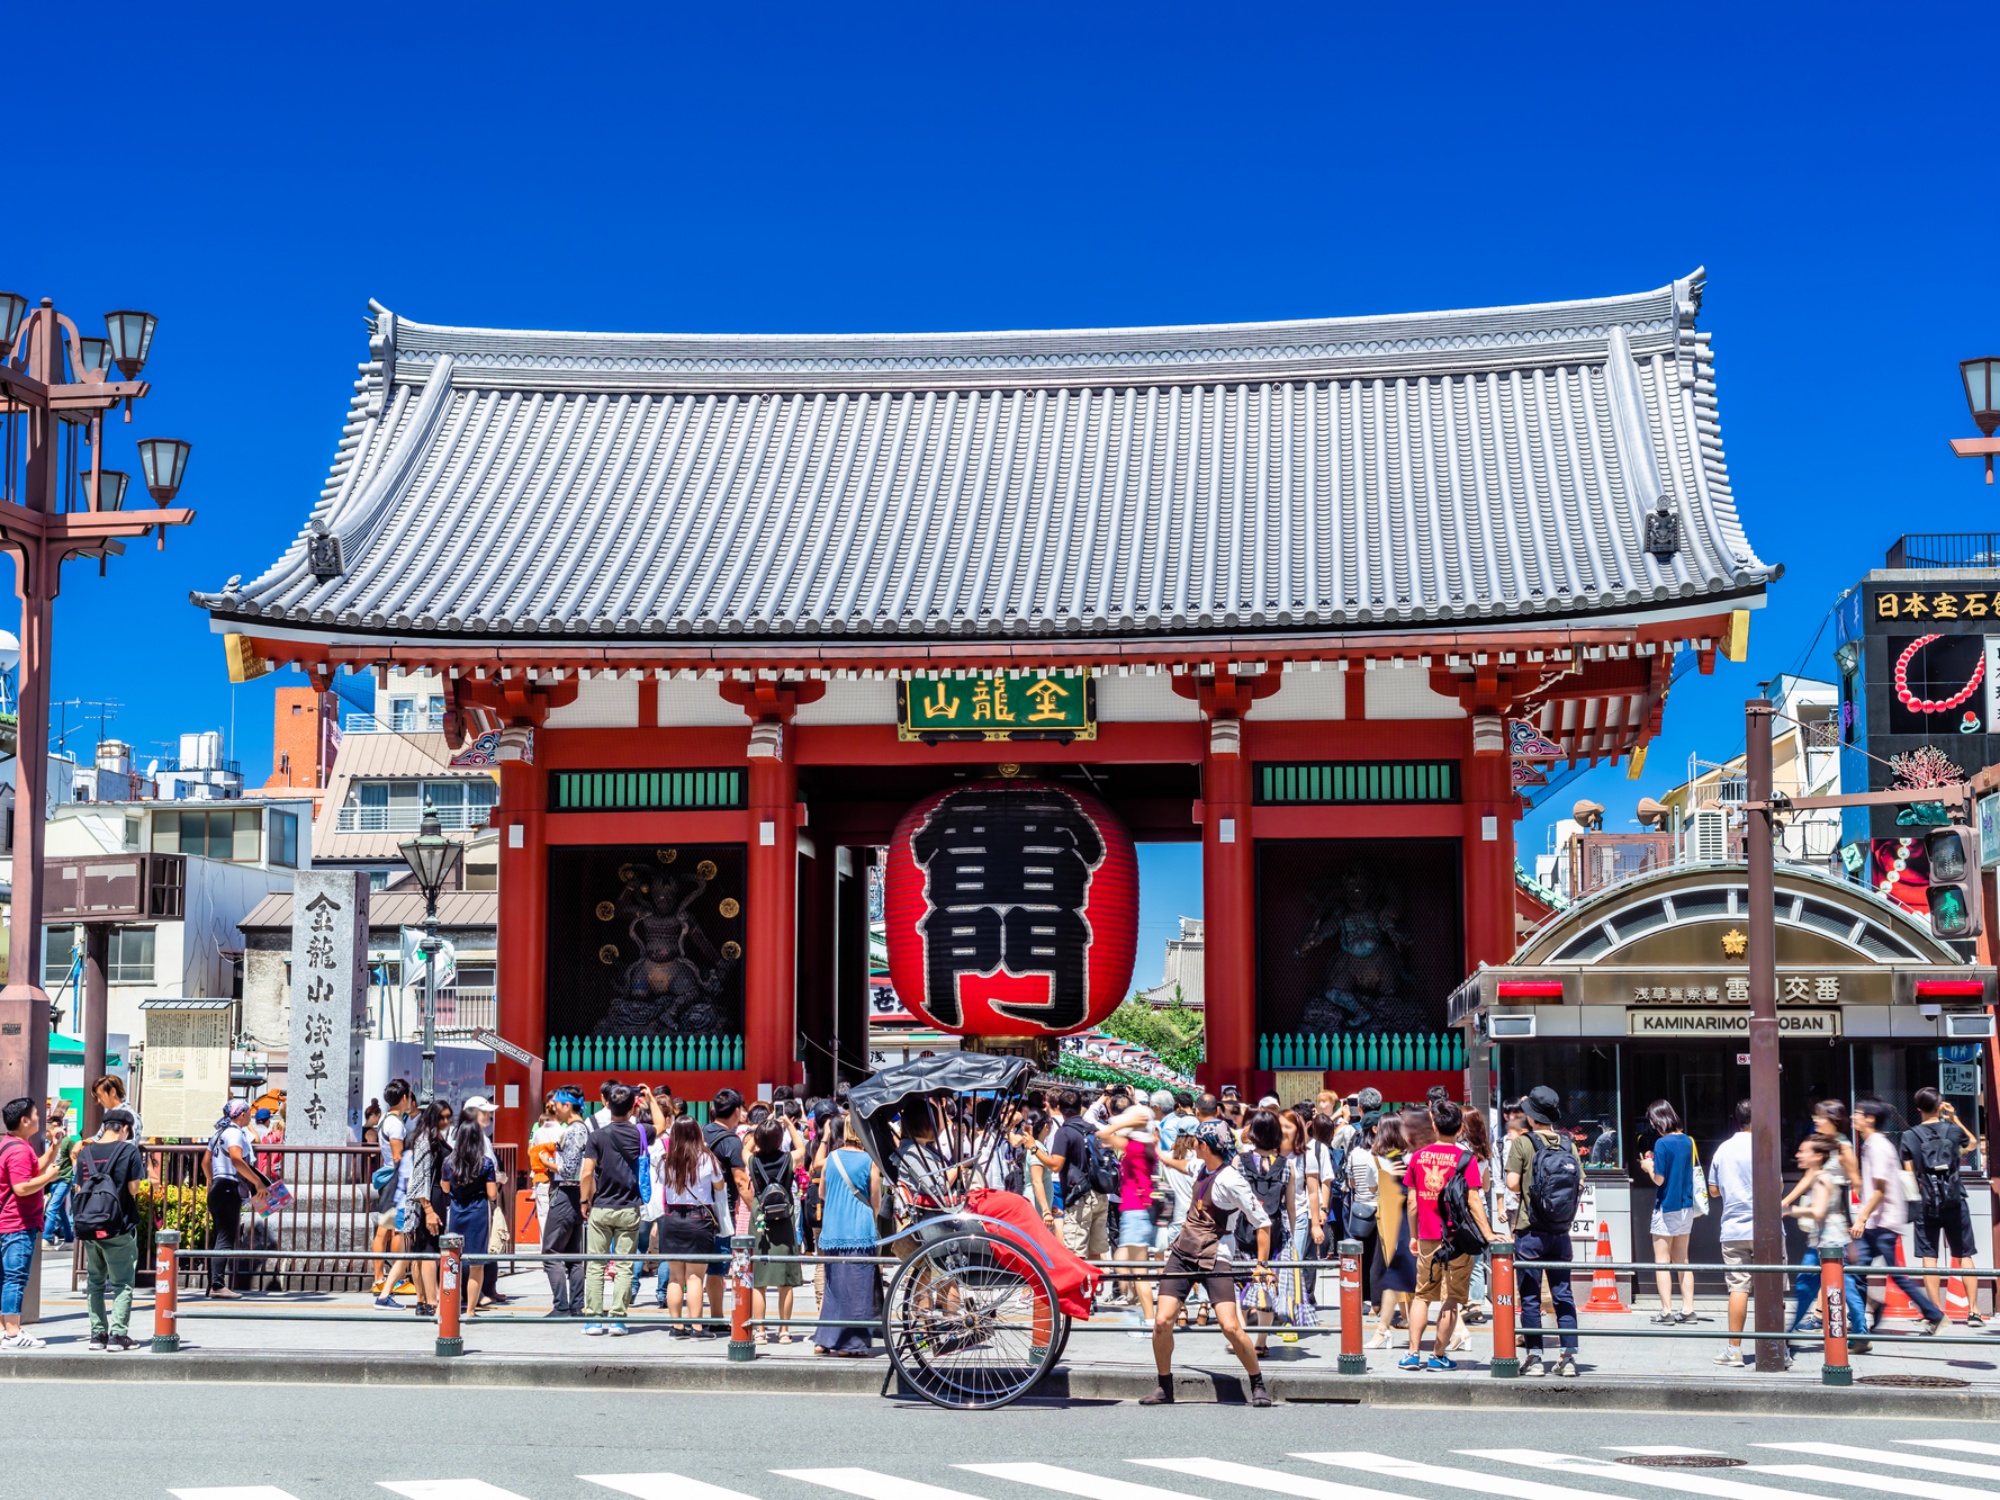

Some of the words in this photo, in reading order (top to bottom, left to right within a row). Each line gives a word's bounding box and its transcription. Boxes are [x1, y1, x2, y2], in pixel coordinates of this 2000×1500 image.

[909, 787, 1108, 1030] 雷門
[1725, 976, 1840, 1002] 雷交番
[1643, 1016, 1750, 1031] KAMINARIMO
[1777, 1016, 1824, 1031] OBAN
[1421, 1151, 1456, 1161] GENUINE
